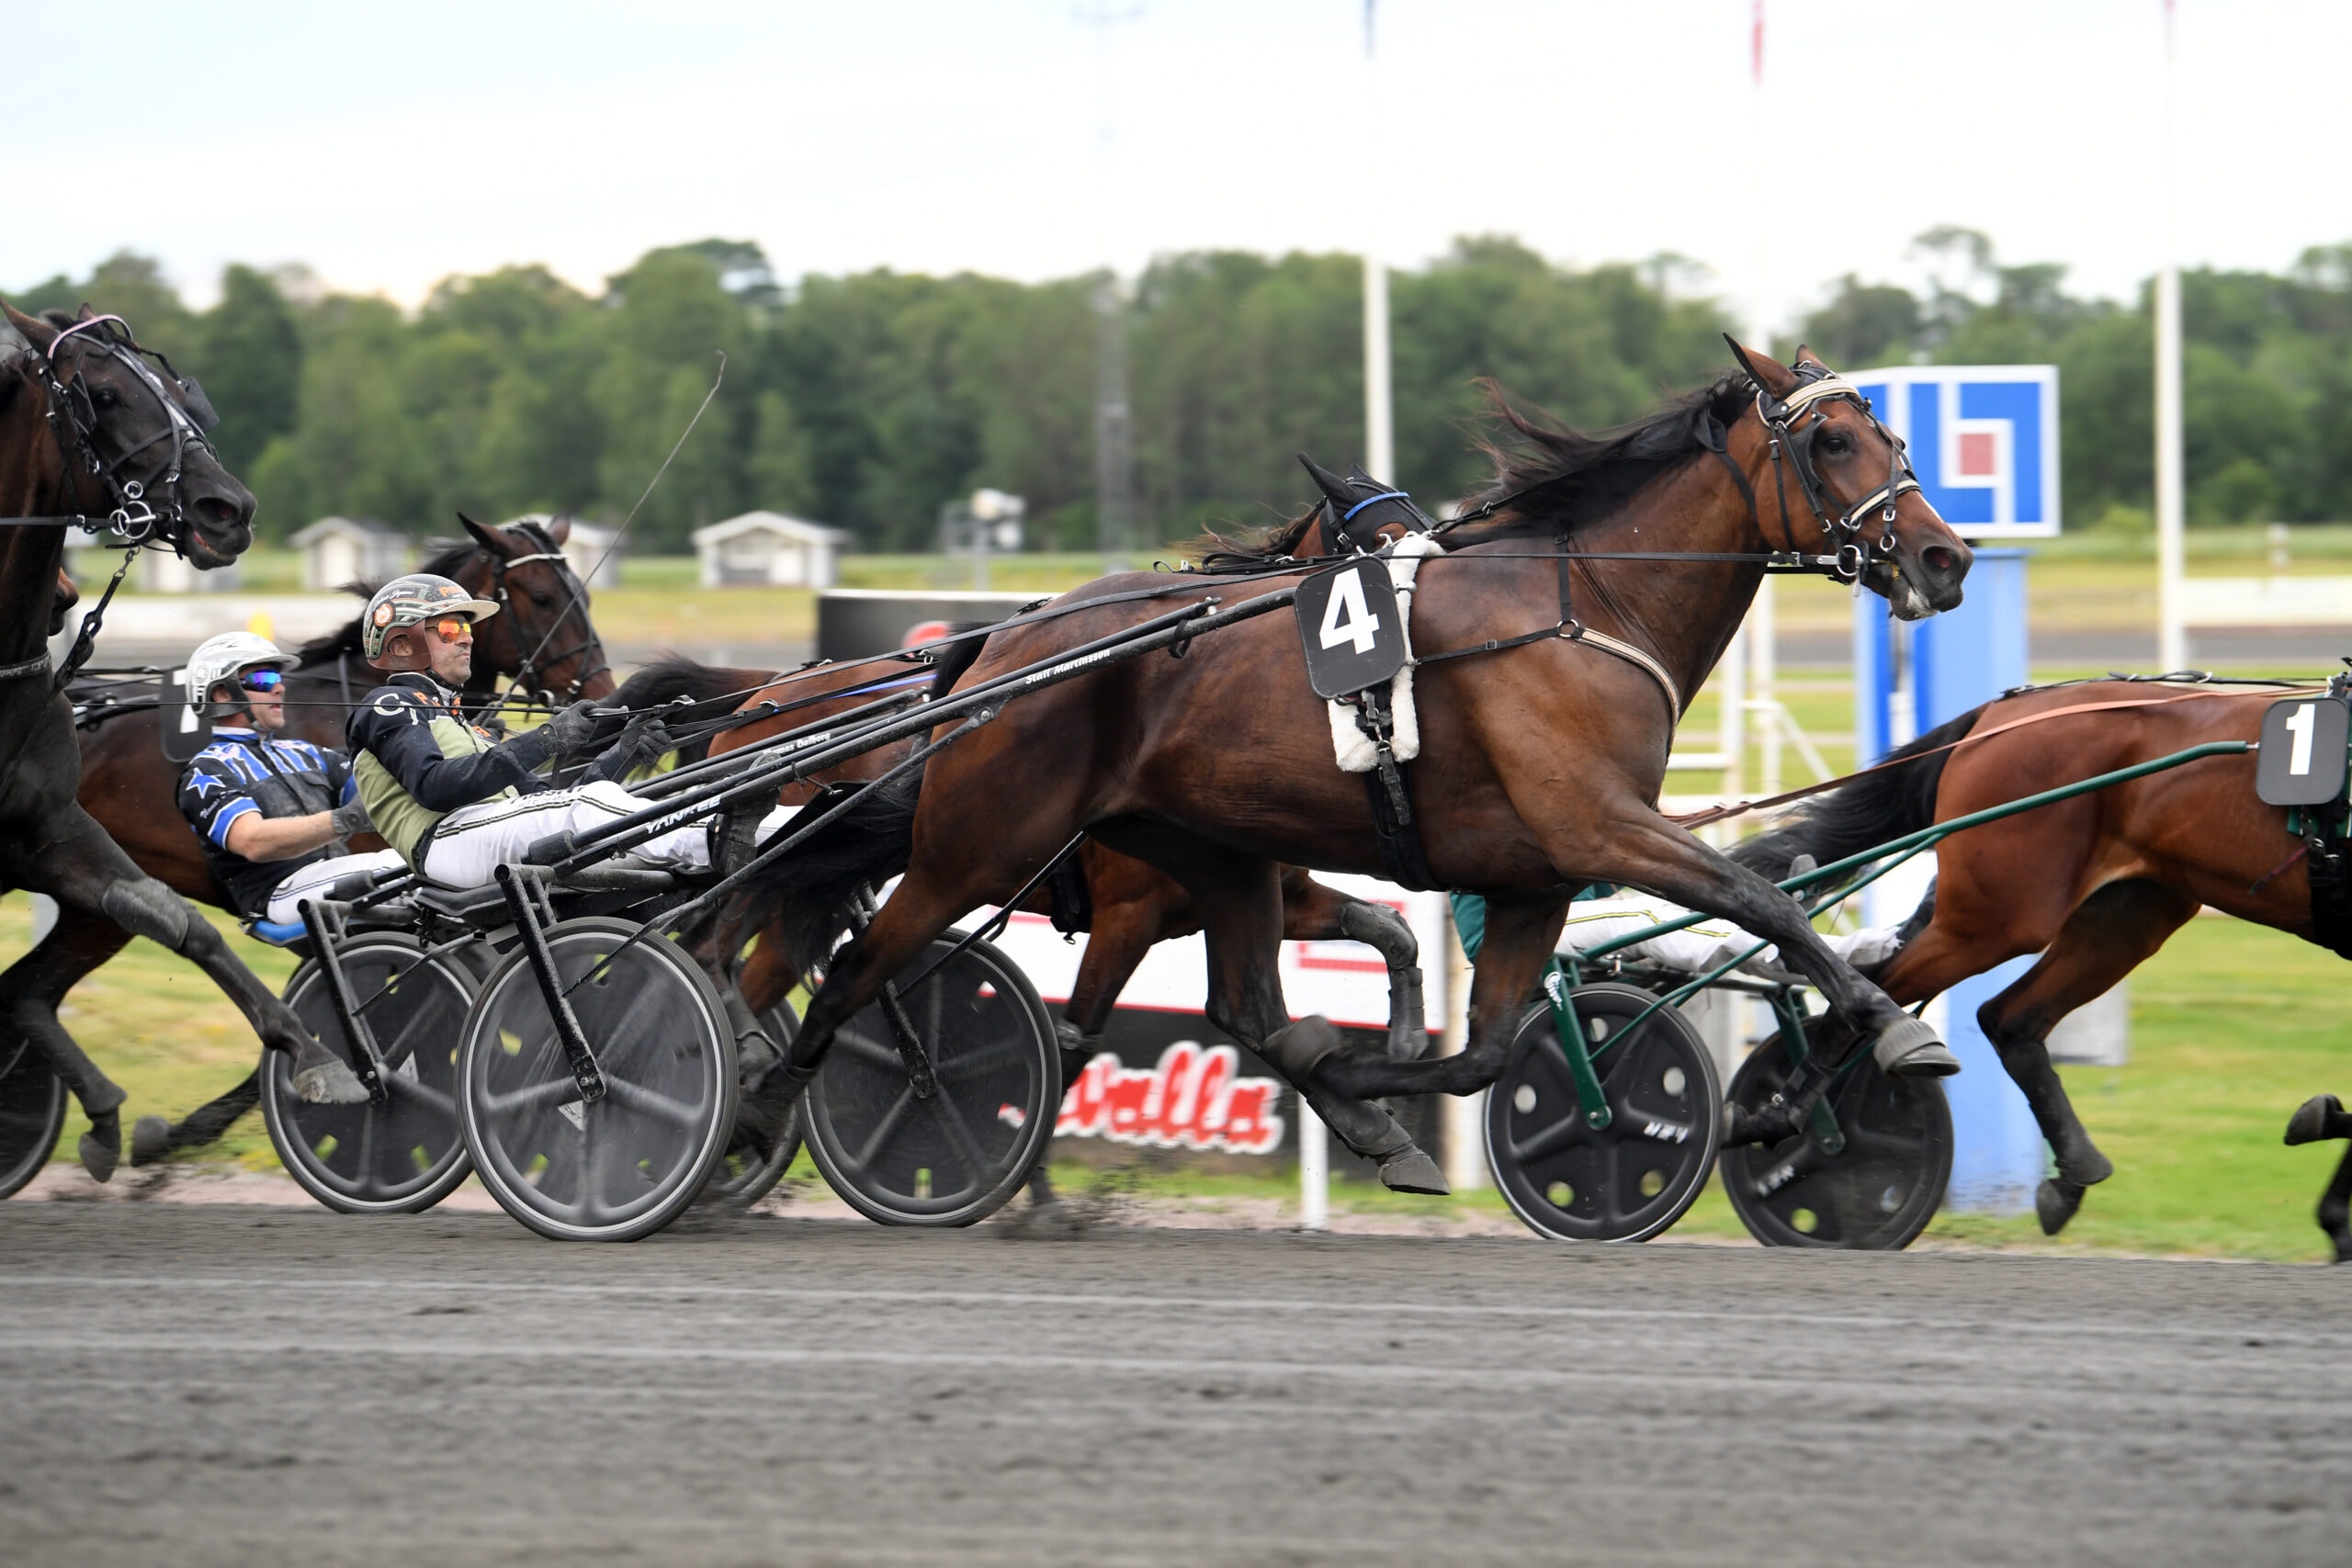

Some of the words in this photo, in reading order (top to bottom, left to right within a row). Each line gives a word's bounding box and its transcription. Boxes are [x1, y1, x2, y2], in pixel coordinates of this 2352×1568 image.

[1319, 567, 1380, 655] 4
[1025, 668, 1051, 684] Stall
[1054, 649, 1111, 675] Martinsson
[2285, 703, 2315, 775] 1
[645, 794, 722, 834] YANKEE
